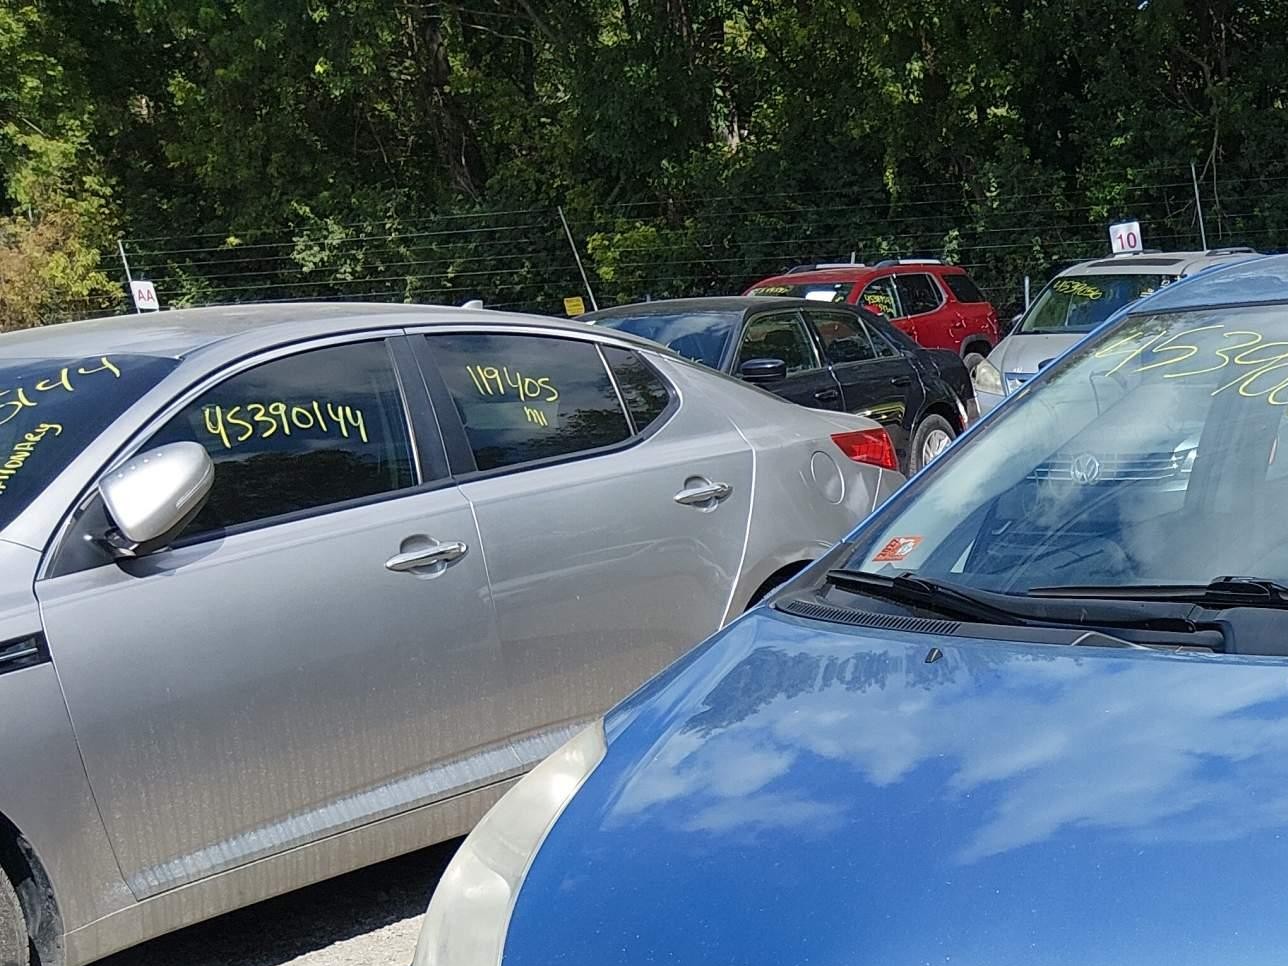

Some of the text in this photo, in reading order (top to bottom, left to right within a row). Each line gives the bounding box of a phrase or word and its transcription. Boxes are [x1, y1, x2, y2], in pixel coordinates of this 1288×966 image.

[1116, 232, 1138, 250] 10
[137, 288, 156, 303] AA
[466, 366, 559, 402] 119405
[204, 400, 368, 449] 45390144
